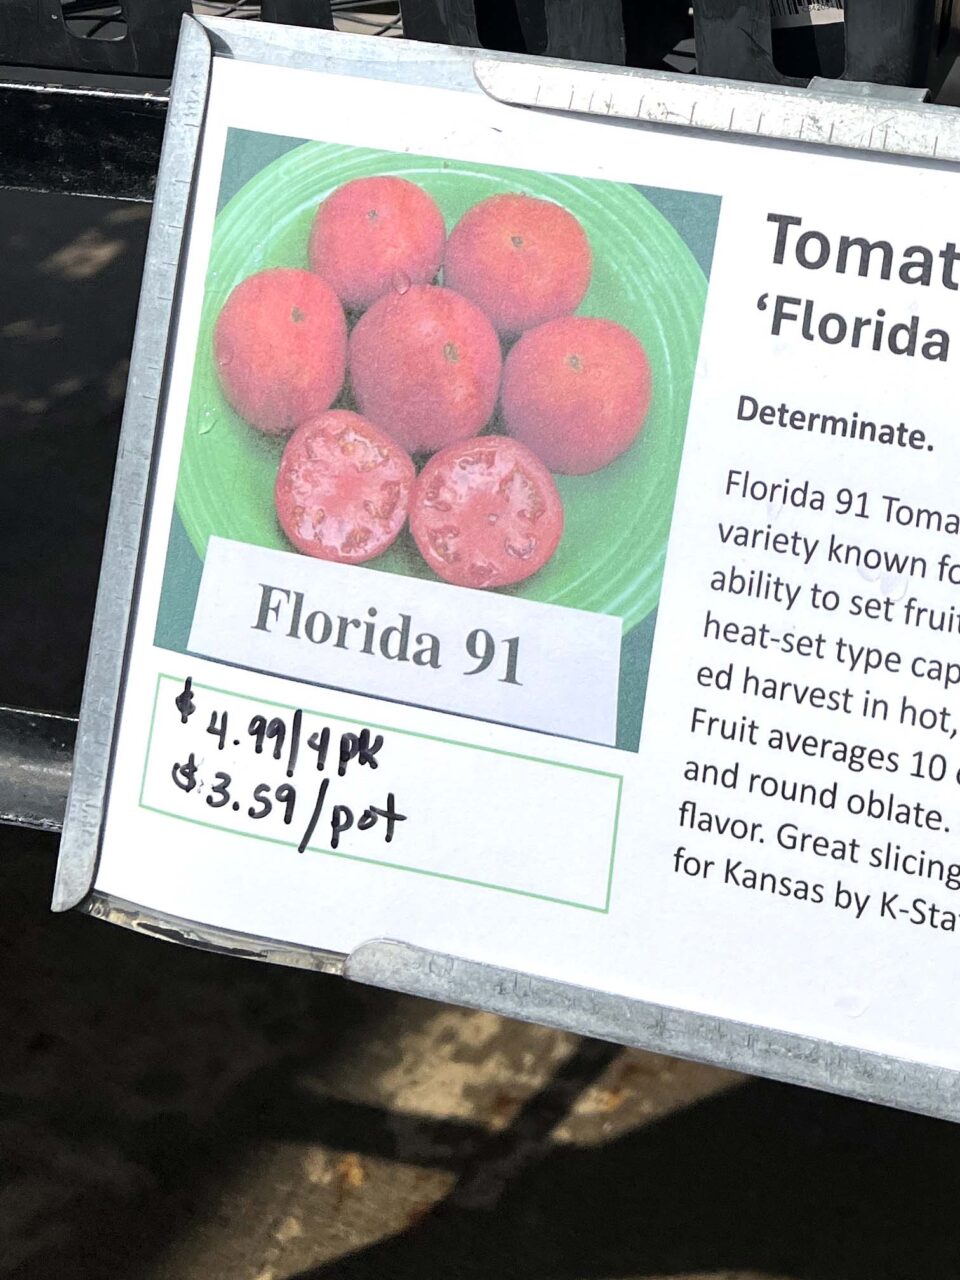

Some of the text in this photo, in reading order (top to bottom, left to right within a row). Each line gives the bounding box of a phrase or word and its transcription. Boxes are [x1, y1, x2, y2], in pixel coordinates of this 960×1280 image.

[757, 293, 950, 362] ‘Florida
[737, 395, 934, 452] Determinate.
[725, 469, 825, 511] Florida
[835, 488, 869, 519] 91
[718, 523, 820, 565] variety
[828, 534, 927, 578] known
[710, 565, 802, 611] ability
[810, 583, 840, 611] to
[849, 595, 895, 622] set
[250, 582, 524, 686] Florida 91
[703, 610, 826, 659] heat-set
[835, 637, 902, 675] type
[697, 663, 734, 691] ed
[742, 666, 854, 714] harvest
[863, 697, 888, 721] in
[900, 695, 957, 740] hot,
[691, 707, 759, 746] Fruit
[768, 729, 899, 773] averages
[910, 751, 947, 782] 10
[171, 753, 408, 853] $3.59/pot
[683, 761, 739, 790] and
[748, 773, 838, 810] round
[847, 789, 950, 833] oblate.
[678, 800, 763, 842] flavor.
[776, 823, 860, 864] Great
[673, 846, 715, 879] for
[724, 858, 824, 904] Kansas
[834, 880, 871, 919] by
